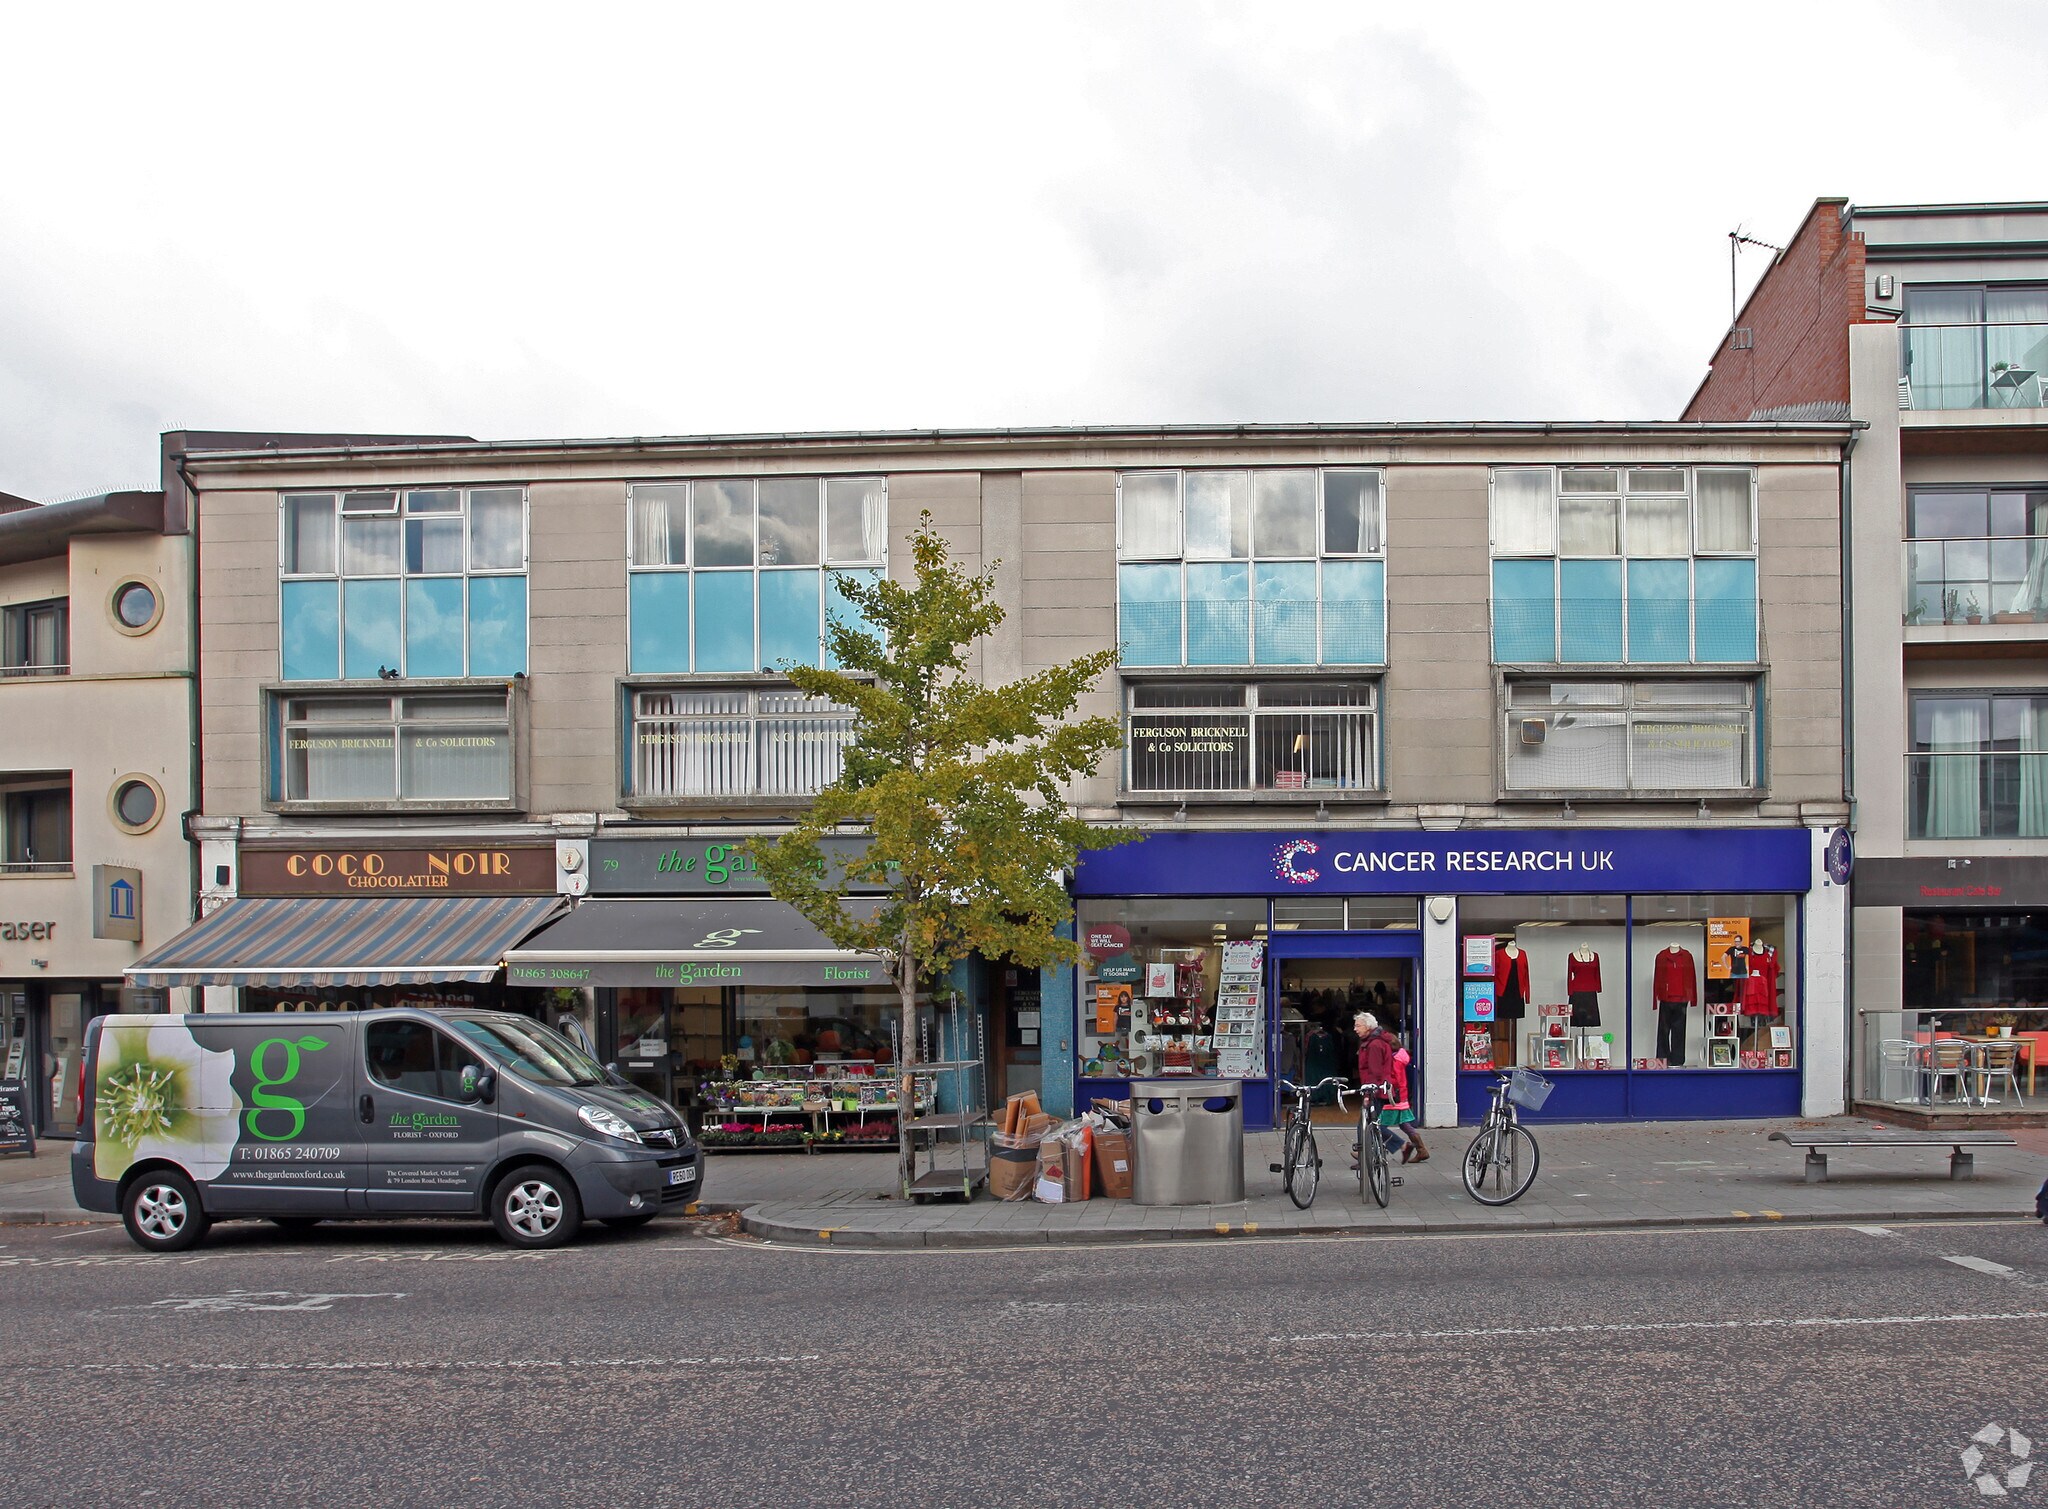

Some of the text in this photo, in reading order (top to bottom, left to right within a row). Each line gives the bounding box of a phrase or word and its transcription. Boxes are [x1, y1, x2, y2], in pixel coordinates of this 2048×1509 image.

[1133, 727, 1249, 738] FERGUSON BRICKNELL
[1634, 724, 1748, 734] FERGUSON BRICKNELL
[289, 738, 394, 749] FERGUSON BRICKNELL
[415, 737, 496, 748] & Co SOLICITORS
[640, 734, 689, 744] FERGUSON
[1147, 742, 1234, 752] & Co SOLICITORS
[287, 853, 511, 877] COCO NOIR
[602, 859, 619, 872] 79
[657, 849, 697, 873] the
[1333, 850, 1614, 872] CANCER RESEARCH UK
[348, 875, 449, 887] CHOCOLATIER
[0, 920, 56, 941] aser
[512, 967, 591, 980] 01865 308647
[655, 962, 742, 985] the garden
[823, 966, 871, 981] Florist
[390, 1112, 457, 1132] the garden
[239, 1147, 340, 1160] T: 01865 240709
[232, 1168, 346, 1181] www.thegardenoxford.co.uk
